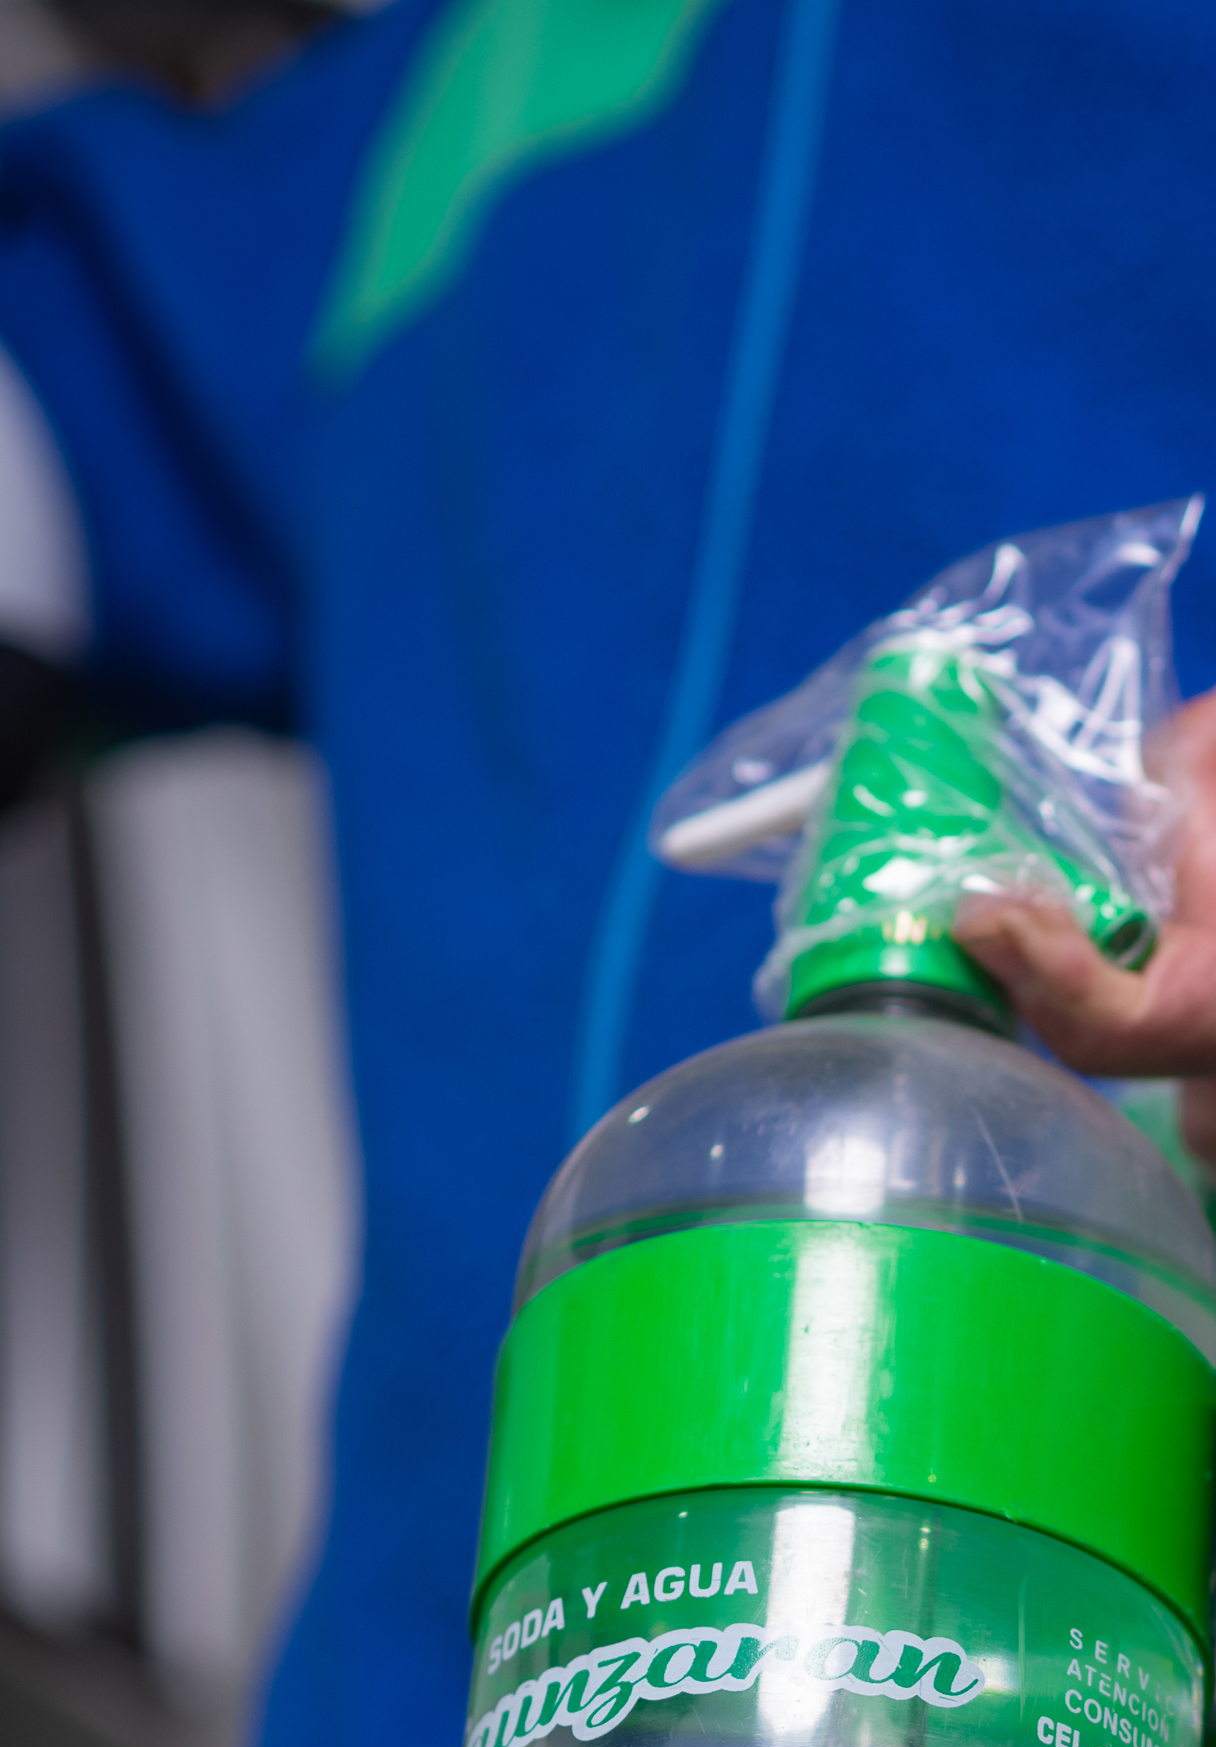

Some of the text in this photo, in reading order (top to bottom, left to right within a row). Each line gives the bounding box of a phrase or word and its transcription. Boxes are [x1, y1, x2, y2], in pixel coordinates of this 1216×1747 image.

[487, 1560, 759, 1676] SODA Y AGUA
